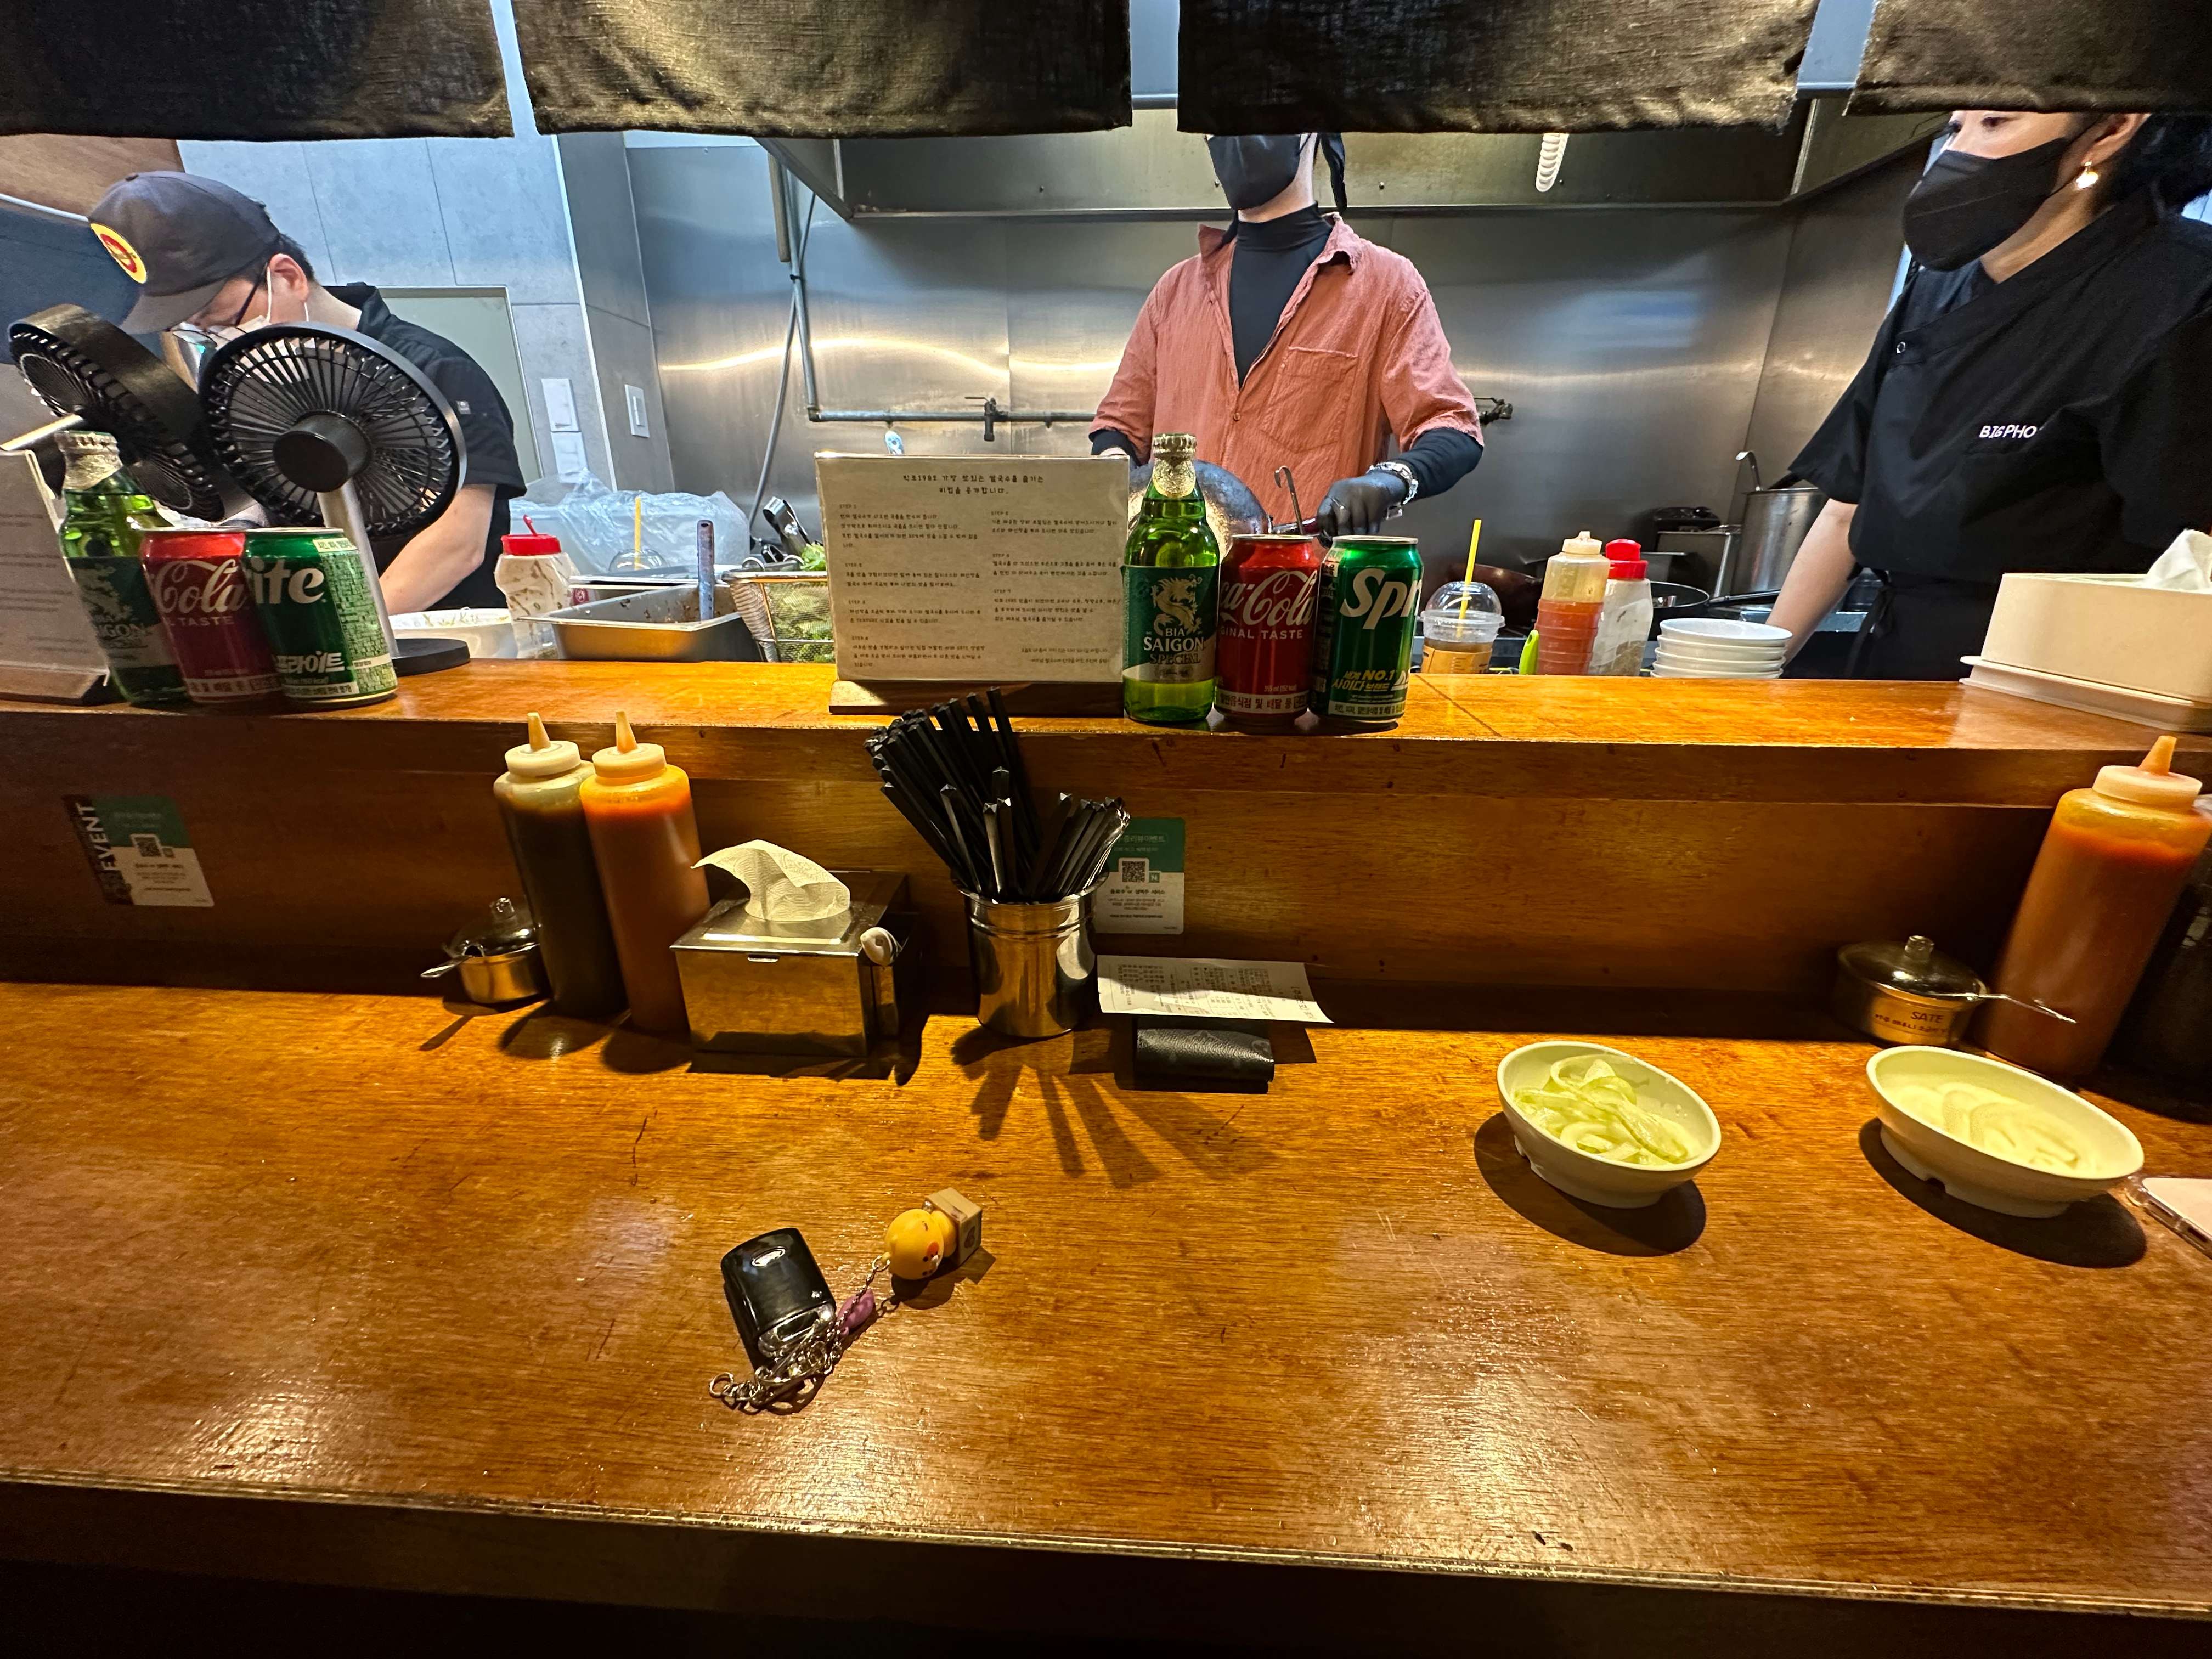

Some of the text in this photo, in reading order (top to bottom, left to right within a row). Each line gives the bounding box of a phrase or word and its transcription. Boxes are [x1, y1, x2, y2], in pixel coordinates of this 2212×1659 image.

[939, 487, 960, 495] 비법을
[155, 558, 249, 613] Cola
[179, 616, 234, 627] TASTE
[1165, 628, 1185, 637] BIA
[1262, 629, 1303, 640] TASTE
[1143, 636, 1204, 652] SAIGON
[275, 650, 346, 674] 프라이트
[1149, 653, 1201, 665] SPECIAL
[1361, 669, 1395, 681] NO.1
[1333, 679, 1365, 691] 사이다
[75, 802, 121, 871] EVENT
[1910, 1011, 1944, 1023] SATE
